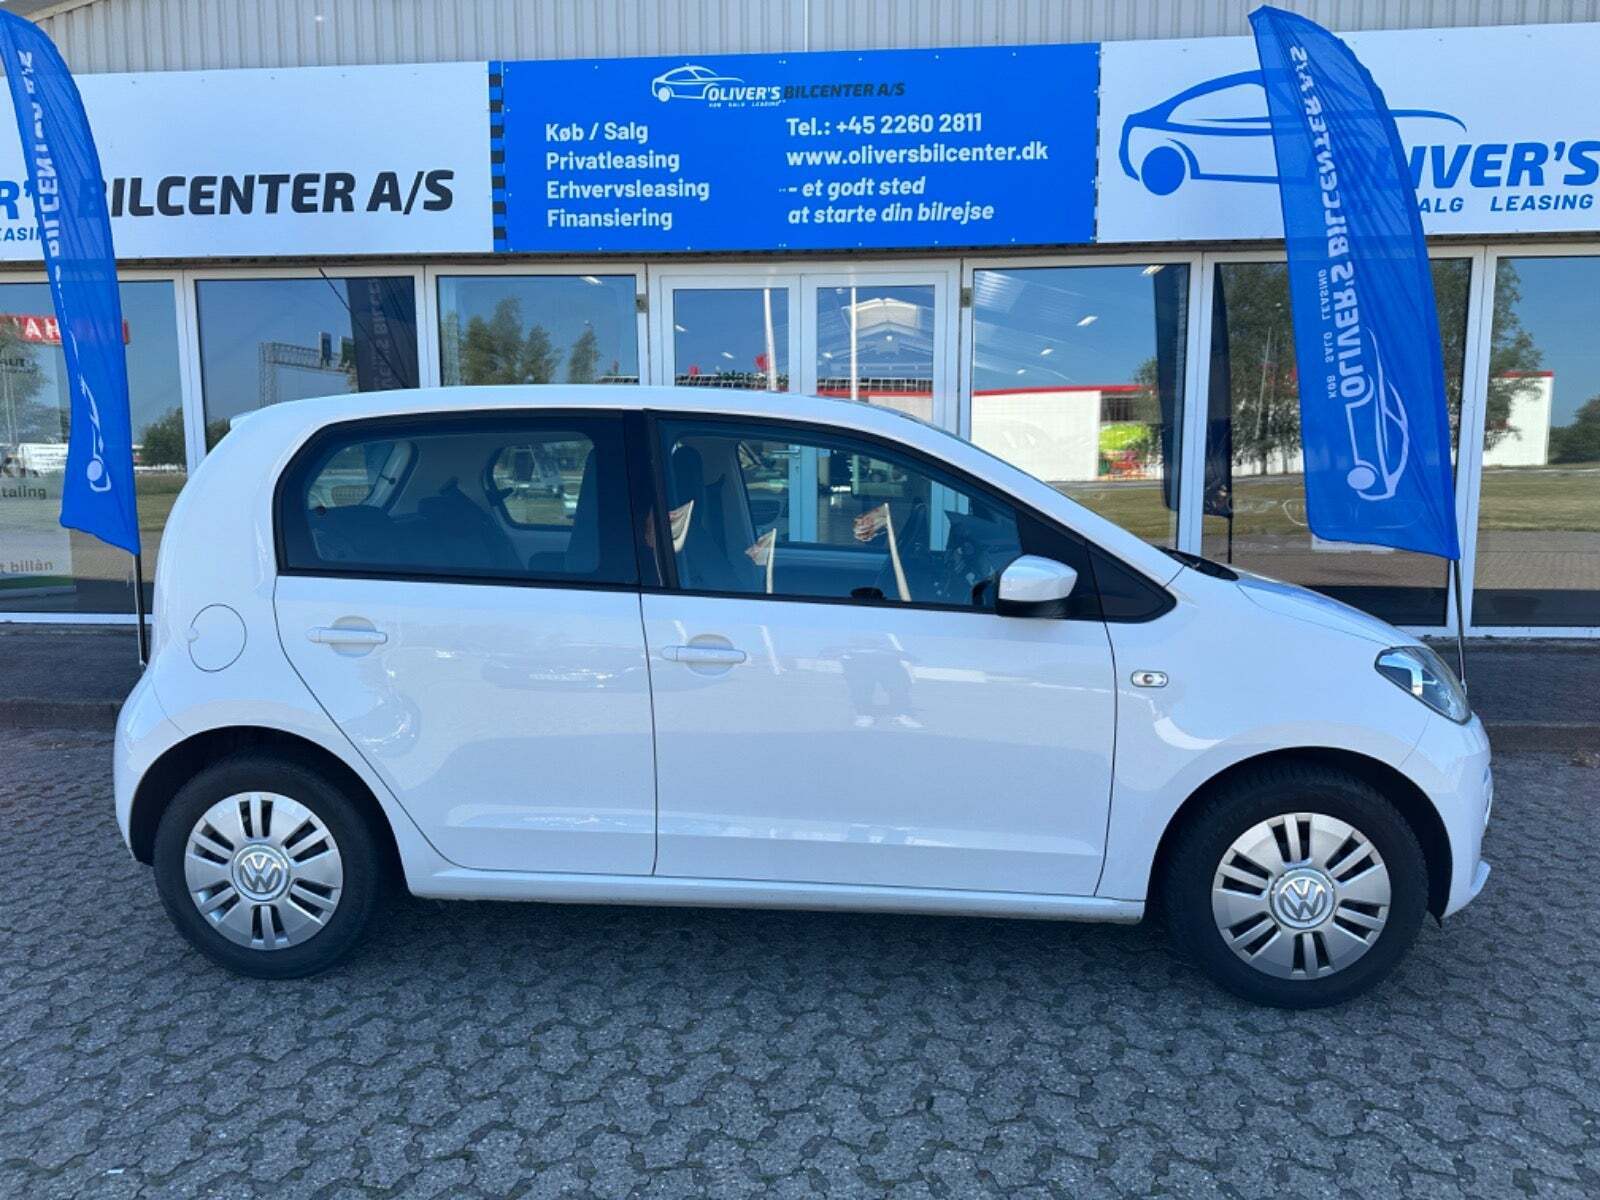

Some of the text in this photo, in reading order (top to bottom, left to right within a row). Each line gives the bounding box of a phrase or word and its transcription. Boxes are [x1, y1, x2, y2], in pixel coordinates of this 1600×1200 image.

[708, 82, 905, 101] OLIVER'S BILCENTER A/S
[545, 121, 648, 144] Køb / Salg
[786, 112, 982, 136] Tel.: +45 2260 2811
[546, 150, 680, 172] Privatleasing
[786, 141, 1048, 166] www.oliversbilcenter.dk
[1408, 140, 1600, 190] IVER'S
[99, 169, 455, 218] ILCENTER A/S
[546, 178, 710, 201] Erhvervsleasing
[802, 179, 823, 197] et
[827, 177, 874, 201] godt
[879, 176, 926, 196] sted
[788, 201, 994, 225] at starte din bilrejse
[1417, 193, 1594, 214] ALG LEASING
[547, 208, 673, 231] Finansiering
